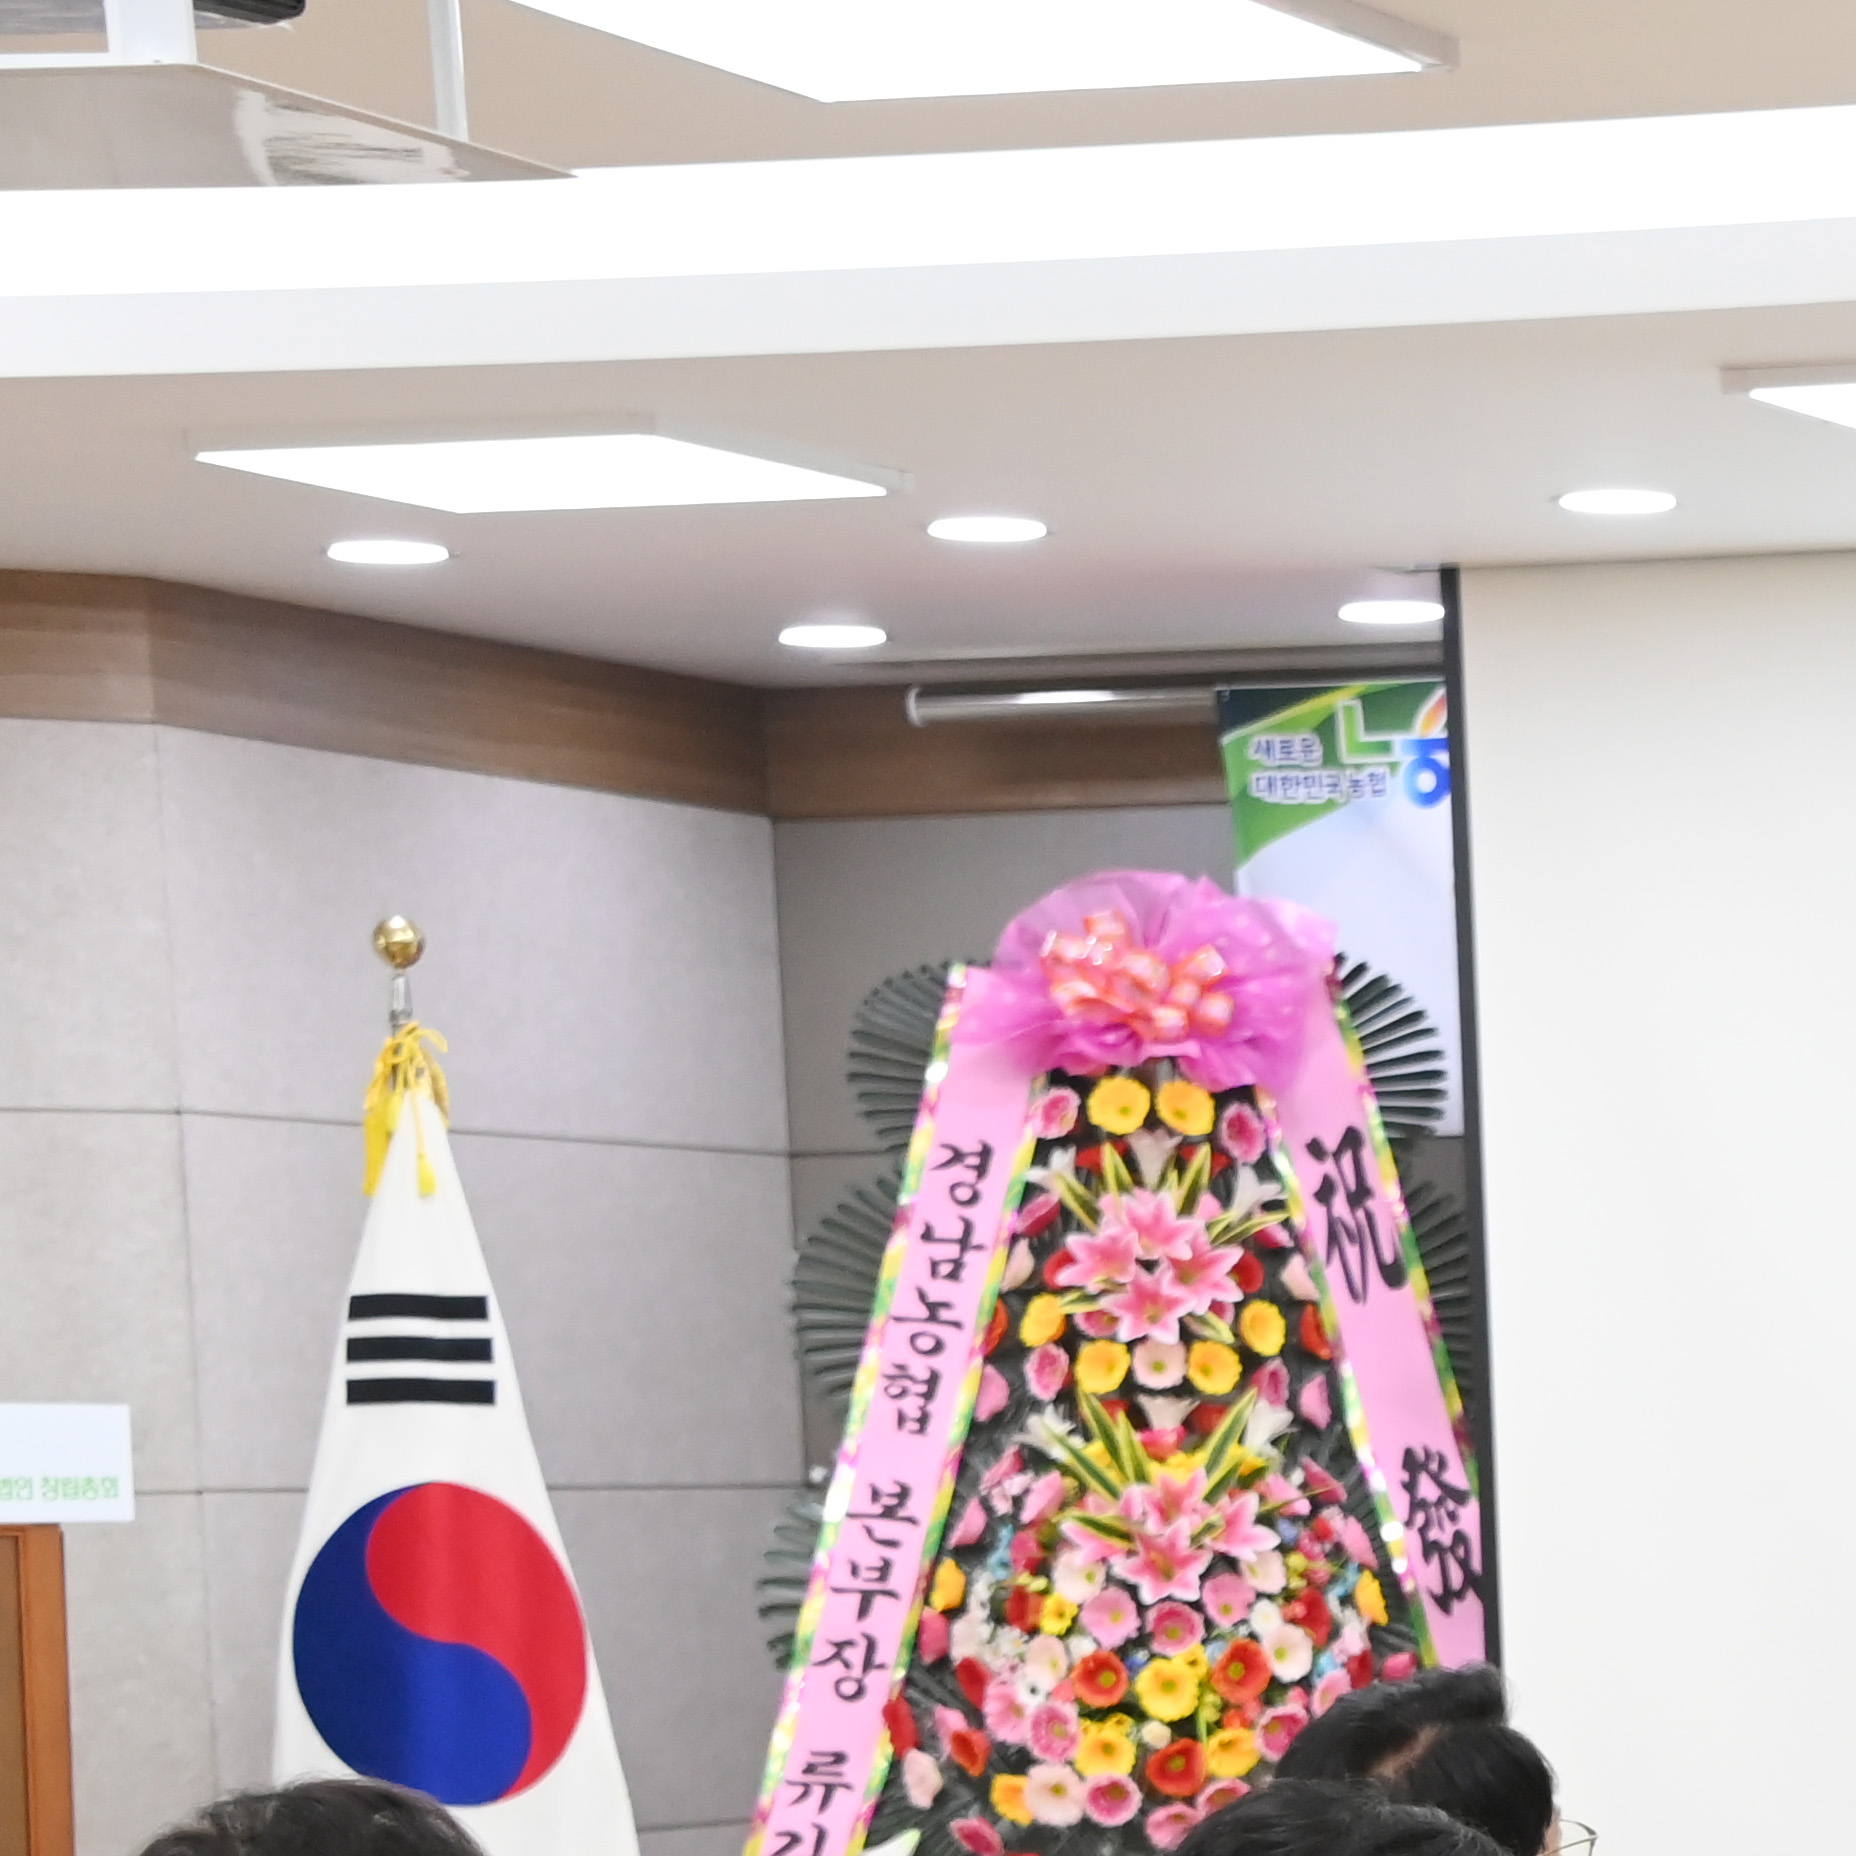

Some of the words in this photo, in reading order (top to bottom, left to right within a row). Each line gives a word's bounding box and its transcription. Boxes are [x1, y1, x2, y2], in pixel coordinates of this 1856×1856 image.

[1254, 737, 1316, 763] 새로운
[883, 1140, 994, 1436] 경남농협
[810, 1480, 920, 1703] 본부장
